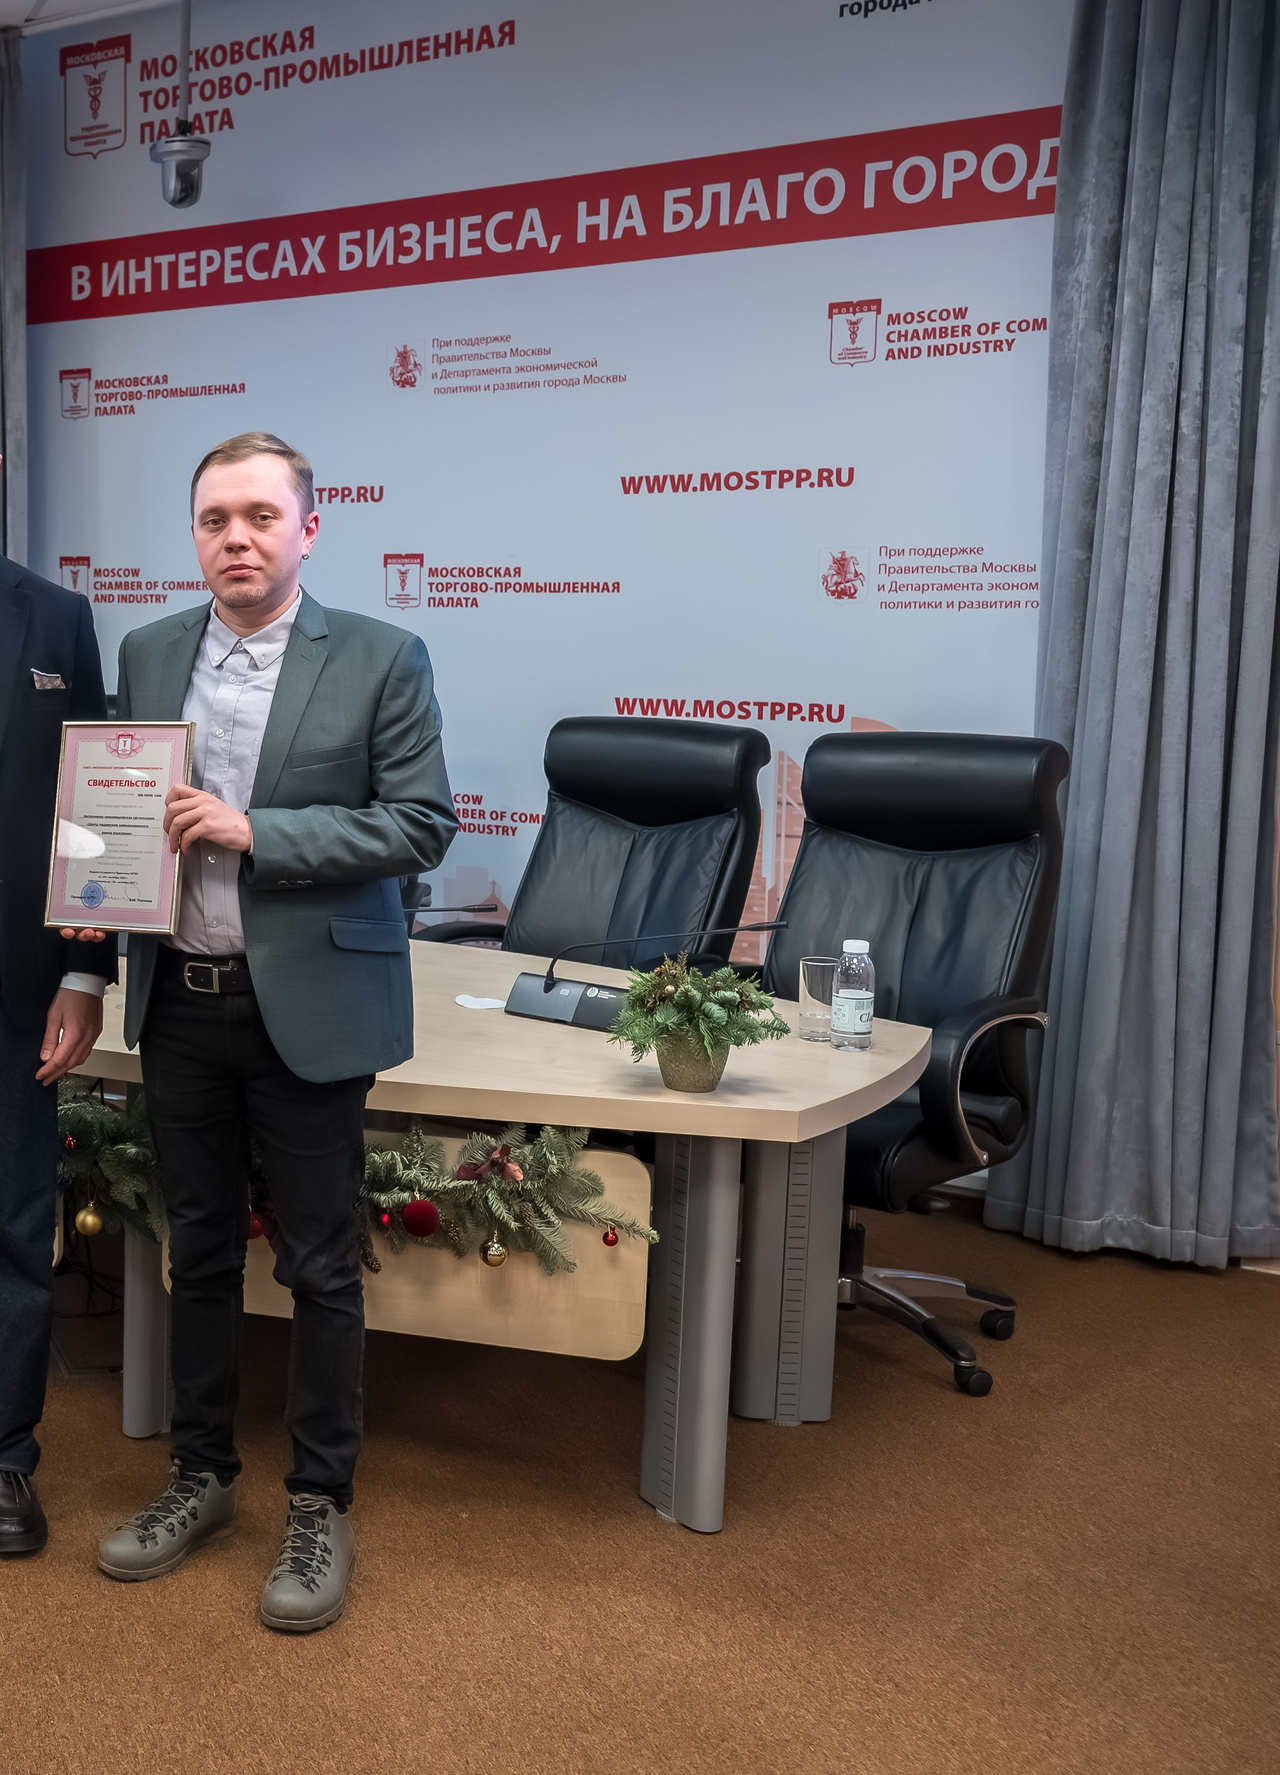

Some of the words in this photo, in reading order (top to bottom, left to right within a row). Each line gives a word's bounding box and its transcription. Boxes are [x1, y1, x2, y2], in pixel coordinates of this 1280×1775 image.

[140, 25, 315, 82] МОКОВСКАЯ
[140, 107, 235, 145] ПААТА
[71, 265, 92, 300] В
[102, 235, 327, 297] ИНТЕРЕСАХ
[338, 207, 562, 271] БИЗНЕСА,
[576, 194, 647, 243] НА
[663, 167, 846, 233] БЛАГО
[832, 304, 877, 314] MOSCOW
[886, 306, 968, 326] MOSCOW
[886, 324, 972, 343] CHAMBER
[976, 321, 1001, 336] OF
[1006, 317, 1048, 334] COM
[432, 338, 452, 350] При
[454, 334, 512, 347] поддержке
[885, 346, 922, 361] AND
[927, 338, 1016, 358] INDUSTRY
[432, 351, 507, 365] Правительства
[509, 347, 552, 358] Москвы
[431, 371, 438, 380] и
[439, 365, 512, 381] Департамента
[514, 357, 598, 374] экономической
[94, 374, 168, 390] МОСКОВСКАЯ
[433, 384, 482, 395] политики
[484, 383, 491, 392] и
[492, 380, 541, 393] развития
[543, 378, 581, 390] города
[583, 373, 627, 385] Москвы
[94, 383, 246, 403] ТОРГОВО-ПРОМЫШЛЕННАЯ
[94, 404, 136, 417] ПАЛАТА
[620, 467, 855, 495] WWW.MOSTPP.RU
[878, 546, 905, 560] При
[908, 545, 984, 559] поддержке
[93, 568, 140, 578] MOSCOW
[427, 566, 521, 578] МОСКОВСКАЯ
[878, 563, 978, 577] Правительства
[981, 562, 1037, 573] Москвы
[93, 581, 143, 591] CHAMBER
[145, 581, 159, 591] OF
[427, 581, 621, 593] ТОРГОВО-ПРОМЫШЛЕННАЯ
[877, 583, 885, 592] и
[888, 581, 984, 594] Департамента
[986, 581, 1039, 591] эконом
[93, 594, 115, 603] AND
[117, 594, 168, 604] INDUSTRY
[427, 597, 479, 608] ПАЛАТА
[879, 600, 942, 610] политики
[946, 600, 954, 609] и
[958, 600, 1021, 612] развития
[614, 697, 845, 724] WWW.MOSTPP.RU
[87, 779, 157, 788] СВИДЕТЕЛЬСТВО
[489, 810, 507, 821] OF
